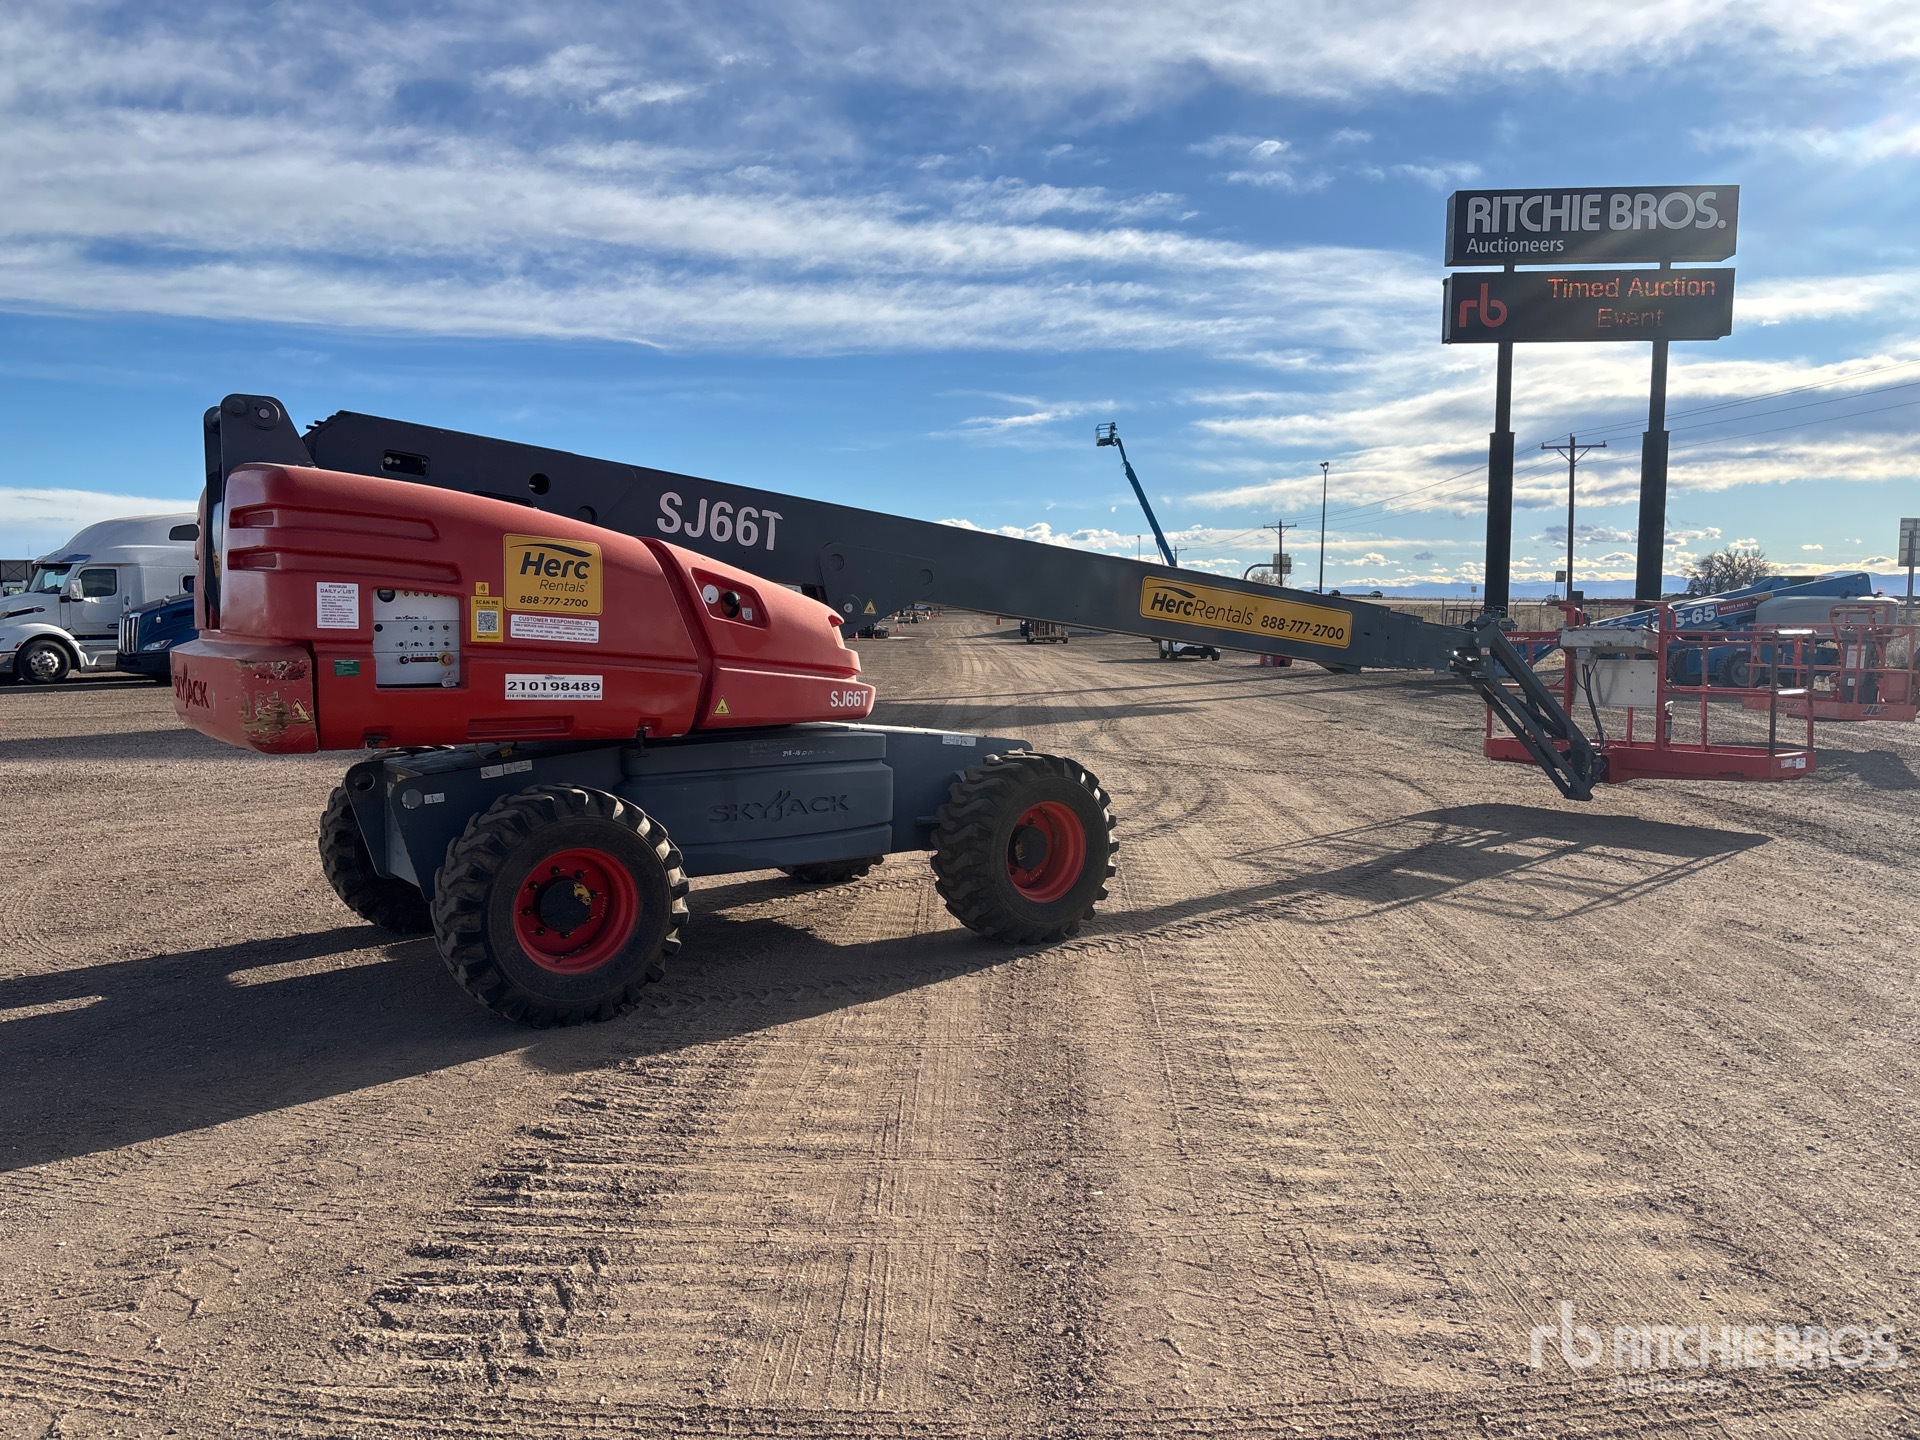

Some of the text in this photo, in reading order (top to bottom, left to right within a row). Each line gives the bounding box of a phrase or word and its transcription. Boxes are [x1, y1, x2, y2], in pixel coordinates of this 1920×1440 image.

[1467, 191, 1727, 234] RITCHIE BROS.
[1466, 237, 1565, 254] Auctioneers
[1548, 276, 1716, 298] Timed Auction
[1459, 283, 1508, 328] rb
[1597, 308, 1664, 328] Event
[656, 491, 784, 551] SJ66T
[520, 552, 590, 579] Herc
[539, 579, 588, 593] Rentals
[519, 595, 589, 608] 888-777-2700
[549, 618, 592, 626] RESPONSIBILITY
[1260, 615, 1345, 640] 888-777-2700
[507, 681, 600, 691] 210198489
[830, 690, 869, 708] SJ66T
[708, 790, 849, 824] SKYJACK
